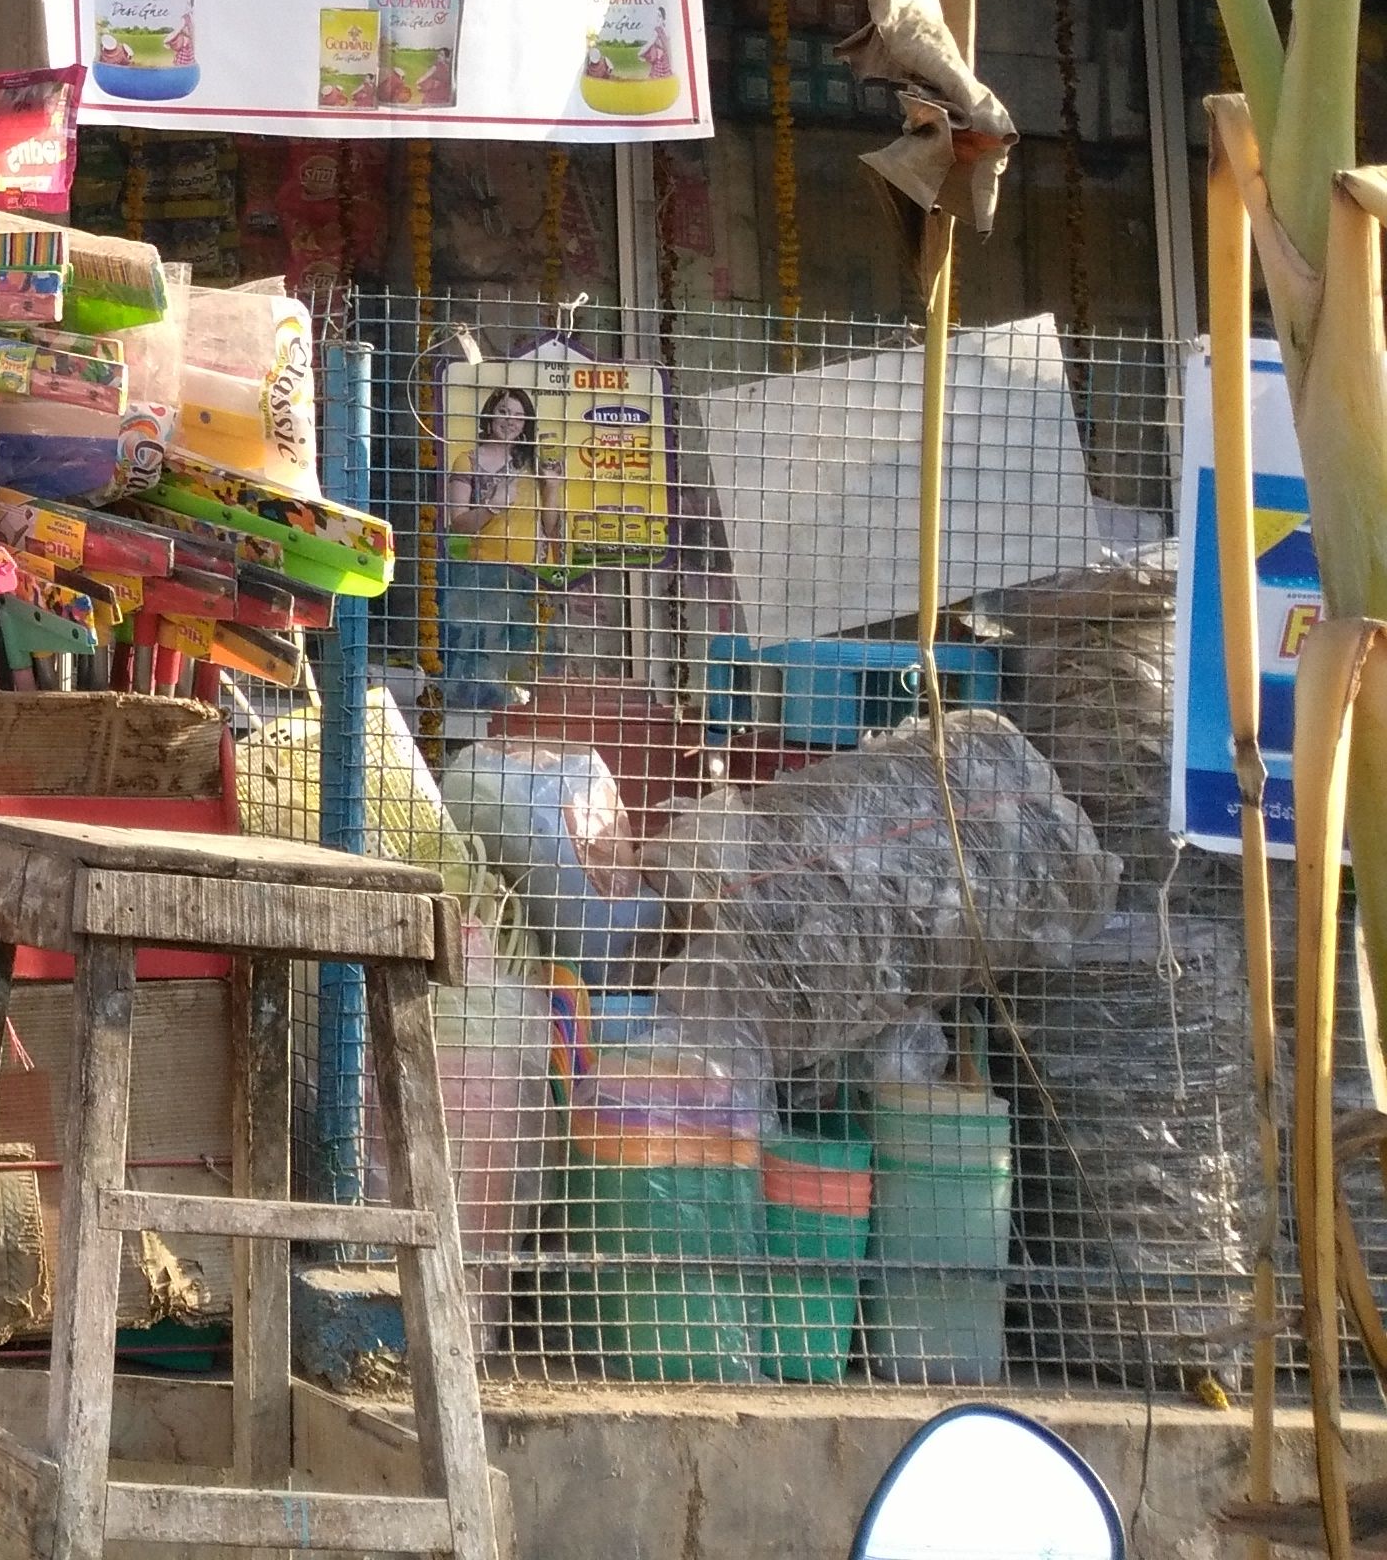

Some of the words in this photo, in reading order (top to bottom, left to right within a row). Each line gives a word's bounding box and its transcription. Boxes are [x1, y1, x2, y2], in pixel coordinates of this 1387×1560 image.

[325, 36, 373, 51] GODAVARI
[573, 369, 630, 390] GHEE
[269, 336, 309, 464] Classic
